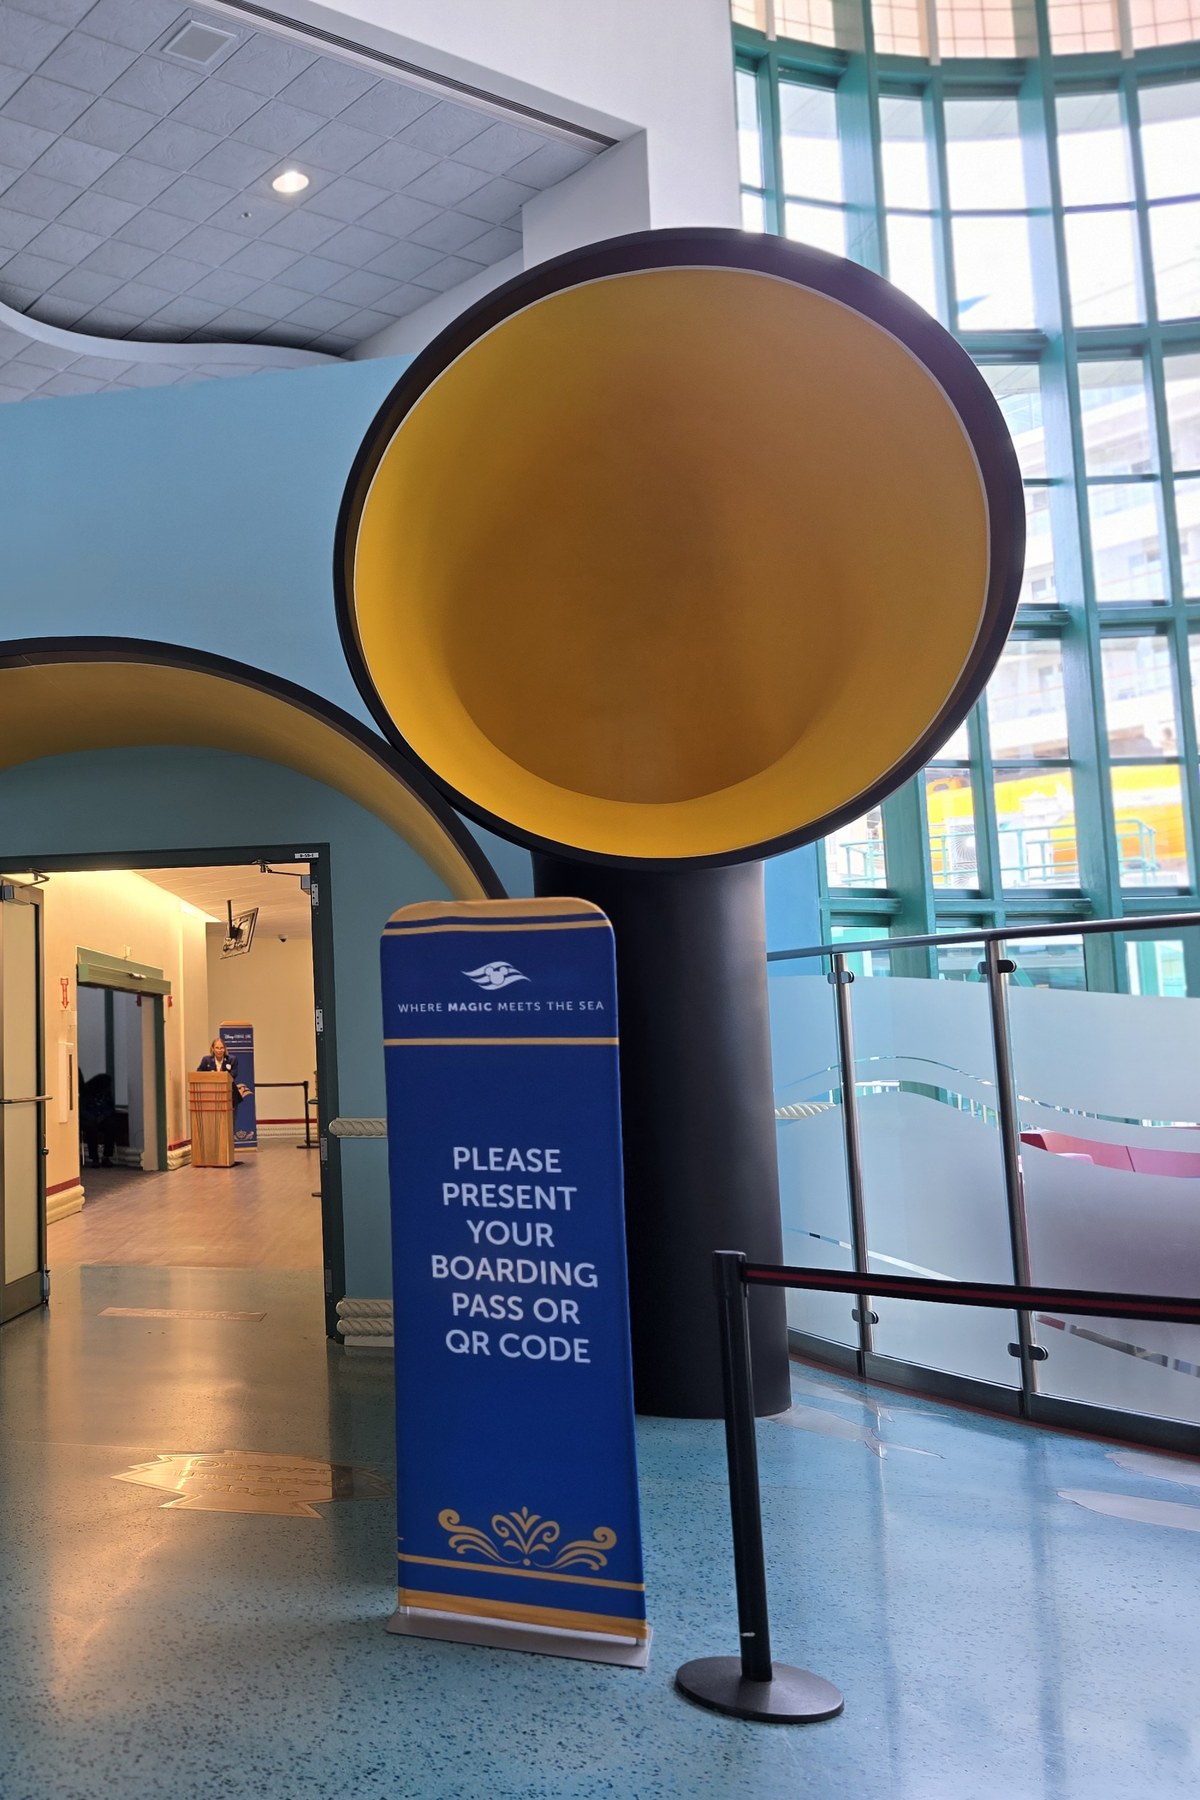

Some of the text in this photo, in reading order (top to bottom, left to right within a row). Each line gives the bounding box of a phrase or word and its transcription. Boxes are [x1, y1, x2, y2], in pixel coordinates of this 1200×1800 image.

[398, 1001, 604, 1012] WHERE MAGIC MEETS THE SEA
[454, 1147, 561, 1172] PLEASE
[443, 1183, 577, 1210] PRESENT
[467, 1220, 554, 1247] YOUR
[432, 1255, 598, 1287] BOARDING
[452, 1293, 580, 1324] PASS OR
[446, 1330, 590, 1363] QR CODE
